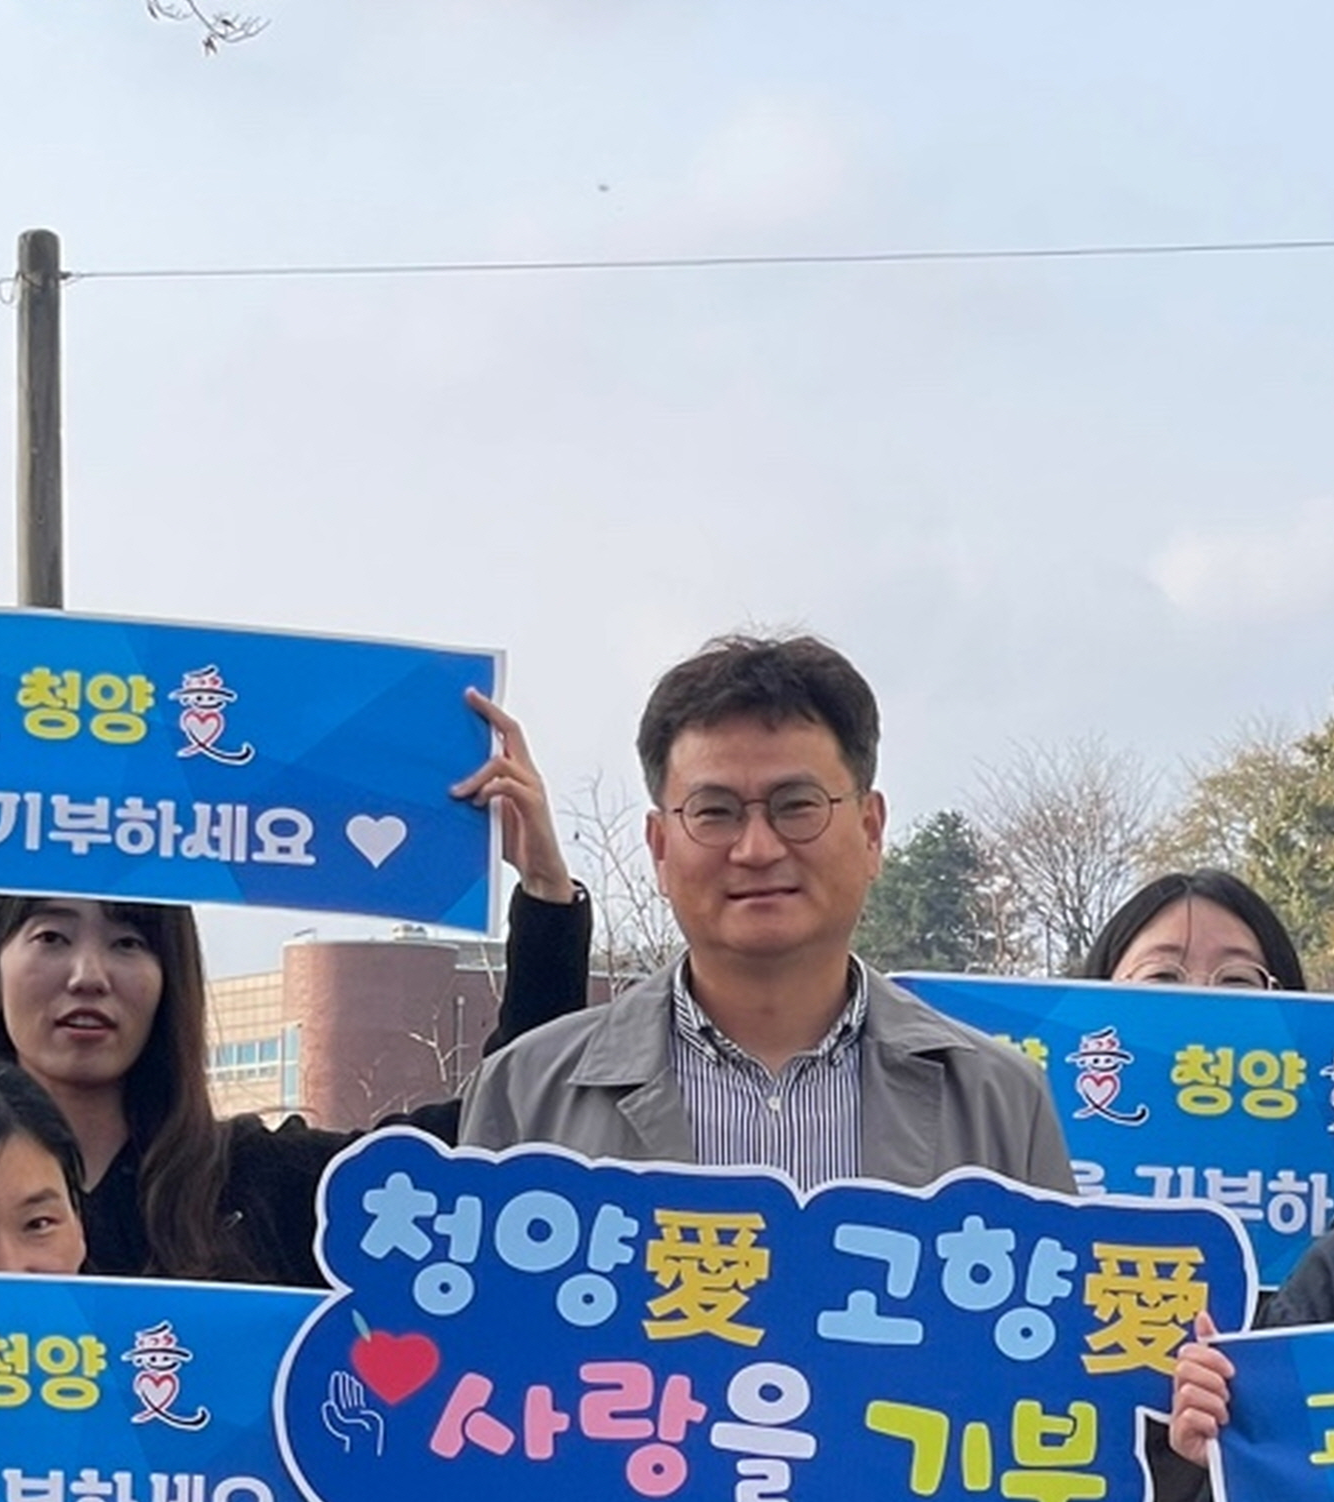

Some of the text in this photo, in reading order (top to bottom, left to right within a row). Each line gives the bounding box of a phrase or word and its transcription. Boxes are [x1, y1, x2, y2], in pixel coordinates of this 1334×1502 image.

[19, 669, 155, 744] 청양
[1172, 1046, 1307, 1119] 청양
[360, 1171, 1210, 1376] 청양愛 고향愛
